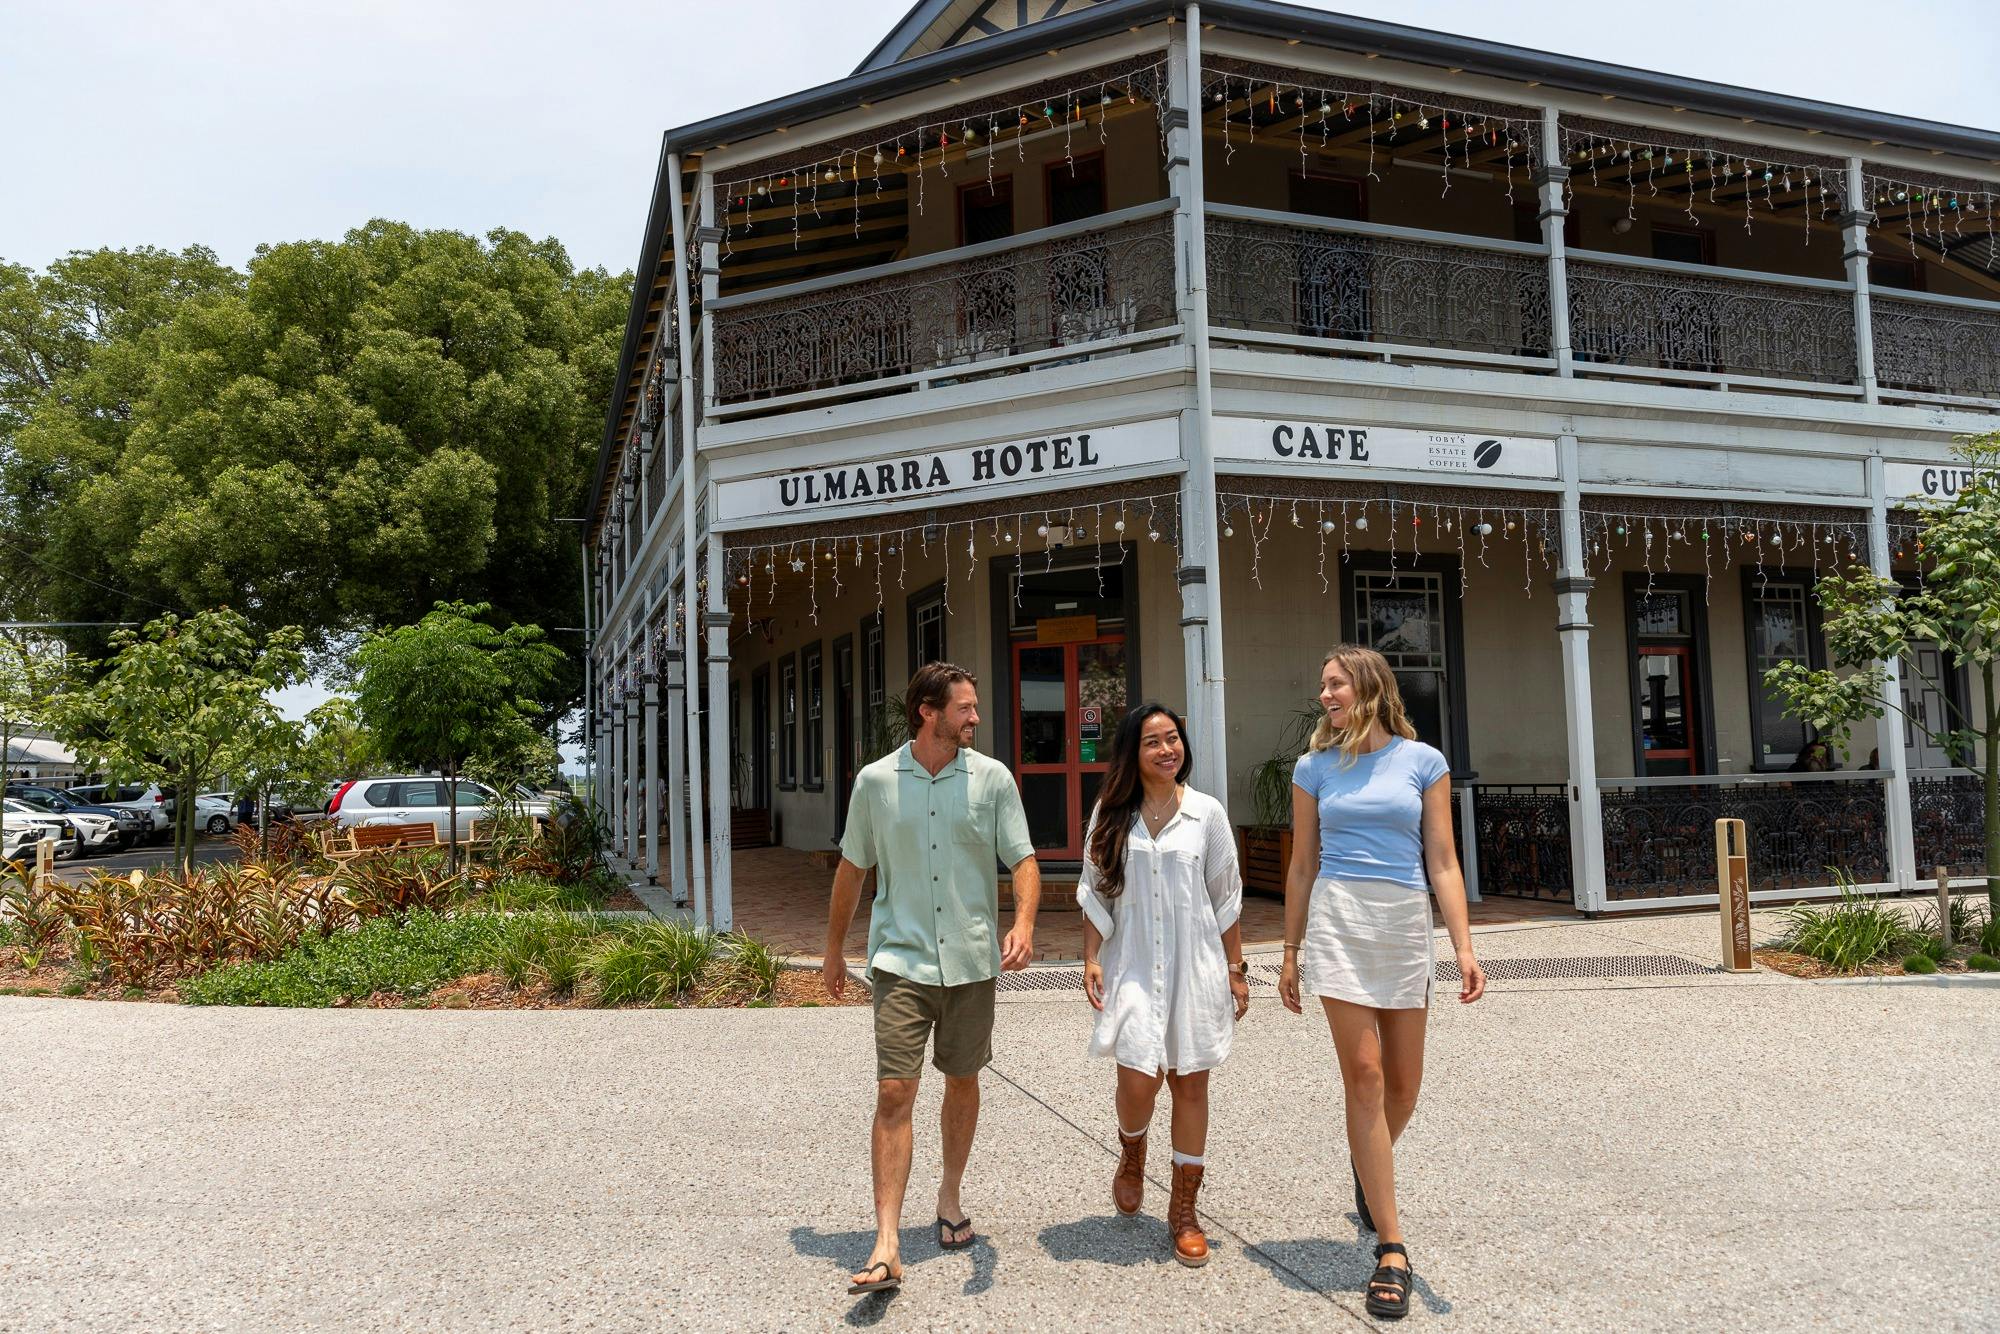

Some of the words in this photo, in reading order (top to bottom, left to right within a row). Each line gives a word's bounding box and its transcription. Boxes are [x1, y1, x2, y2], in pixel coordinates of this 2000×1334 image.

[1272, 424, 1369, 461] CAFE
[1428, 435, 1465, 444] TOBY'S
[1428, 447, 1466, 456] ESTATE
[1429, 459, 1467, 468] COFFEE
[779, 456, 951, 507] ULMARRA
[971, 434, 1099, 481] HOTEL
